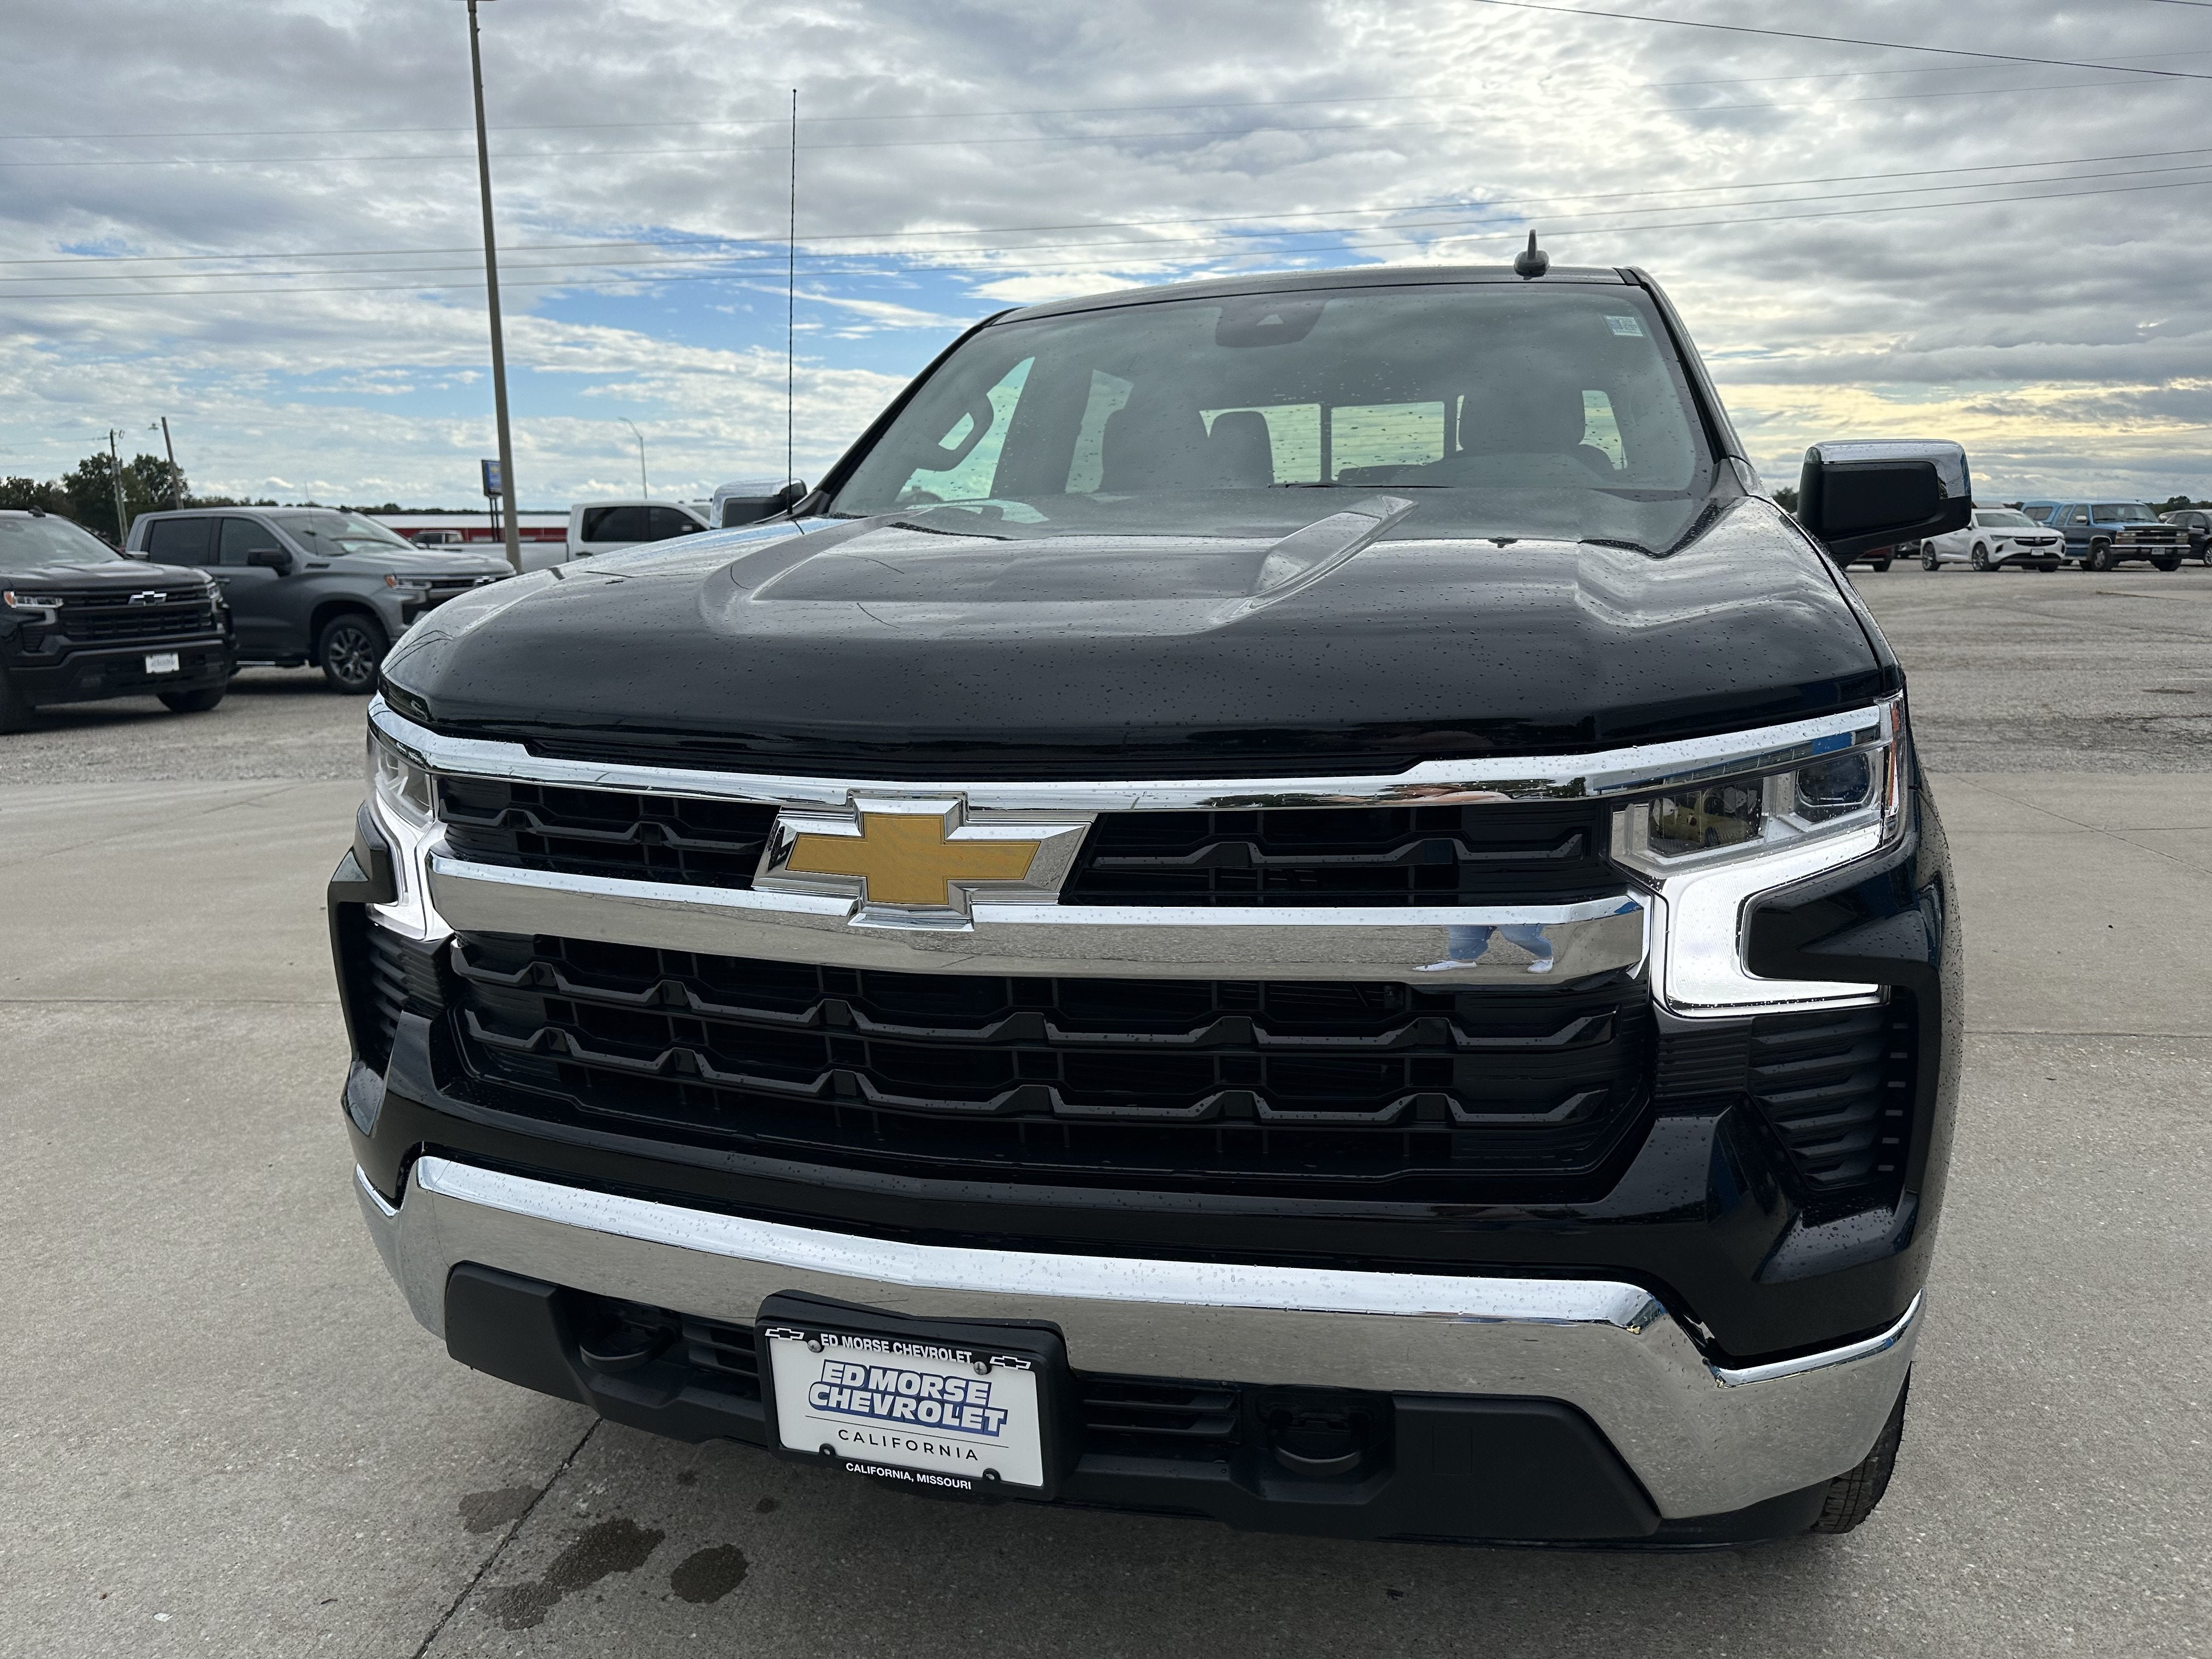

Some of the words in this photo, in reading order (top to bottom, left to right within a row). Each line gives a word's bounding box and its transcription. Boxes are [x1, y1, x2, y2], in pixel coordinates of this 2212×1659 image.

[820, 1334, 838, 1347] ED
[842, 1336, 889, 1354] MORSE
[893, 1342, 972, 1364] CHEVROLET
[822, 1360, 867, 1387] ED
[868, 1368, 990, 1406] MORSE
[809, 1382, 1007, 1436] CHEVROLET
[838, 1429, 979, 1461] CALIFORNIA
[845, 1462, 915, 1483] CALIFORNIA,
[917, 1473, 972, 1490] MISSOURI
